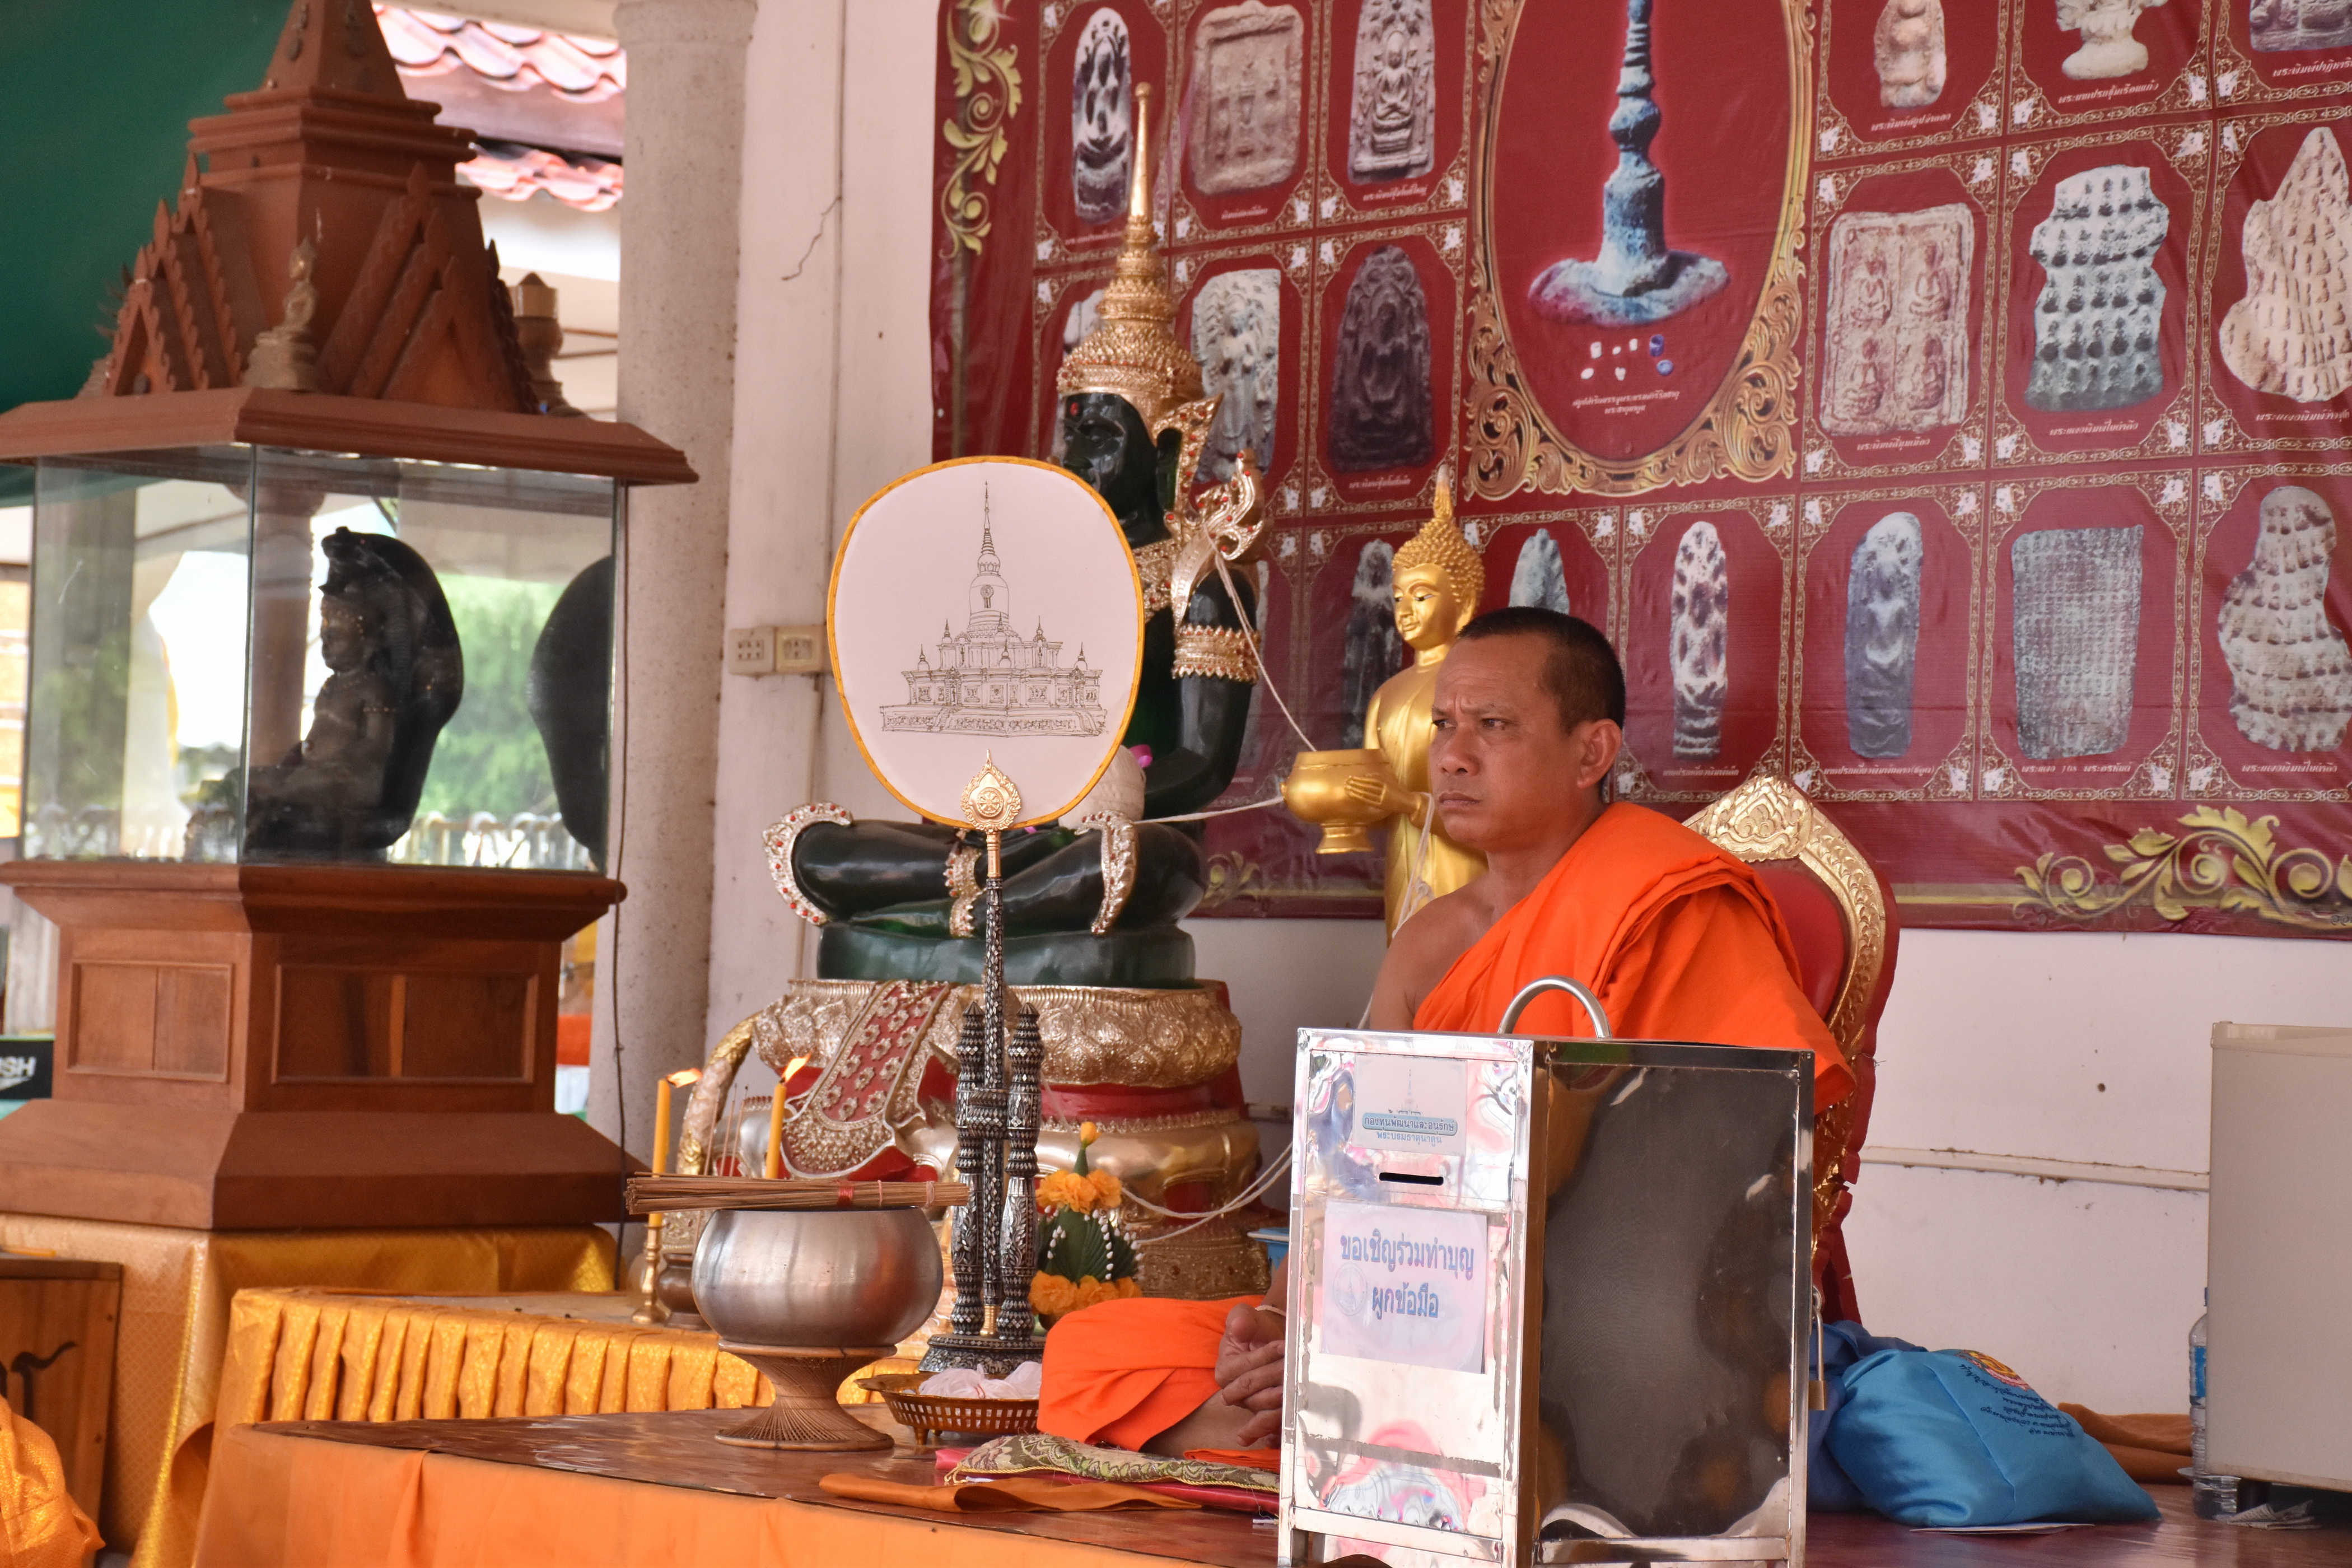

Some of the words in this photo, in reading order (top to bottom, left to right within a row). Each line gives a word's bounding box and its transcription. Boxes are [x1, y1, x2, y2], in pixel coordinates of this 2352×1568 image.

[0, 1056, 36, 1077] SH
[1365, 1116, 1455, 1135] กองทุนพัฒนาและอนุรักษ์
[1376, 1131, 1443, 1147] พระบรมธาตุนาดูน
[1340, 1228, 1474, 1281] ขอเชิญร่วมทำบุญ
[1372, 1282, 1439, 1320] ผูกข้อมือ
